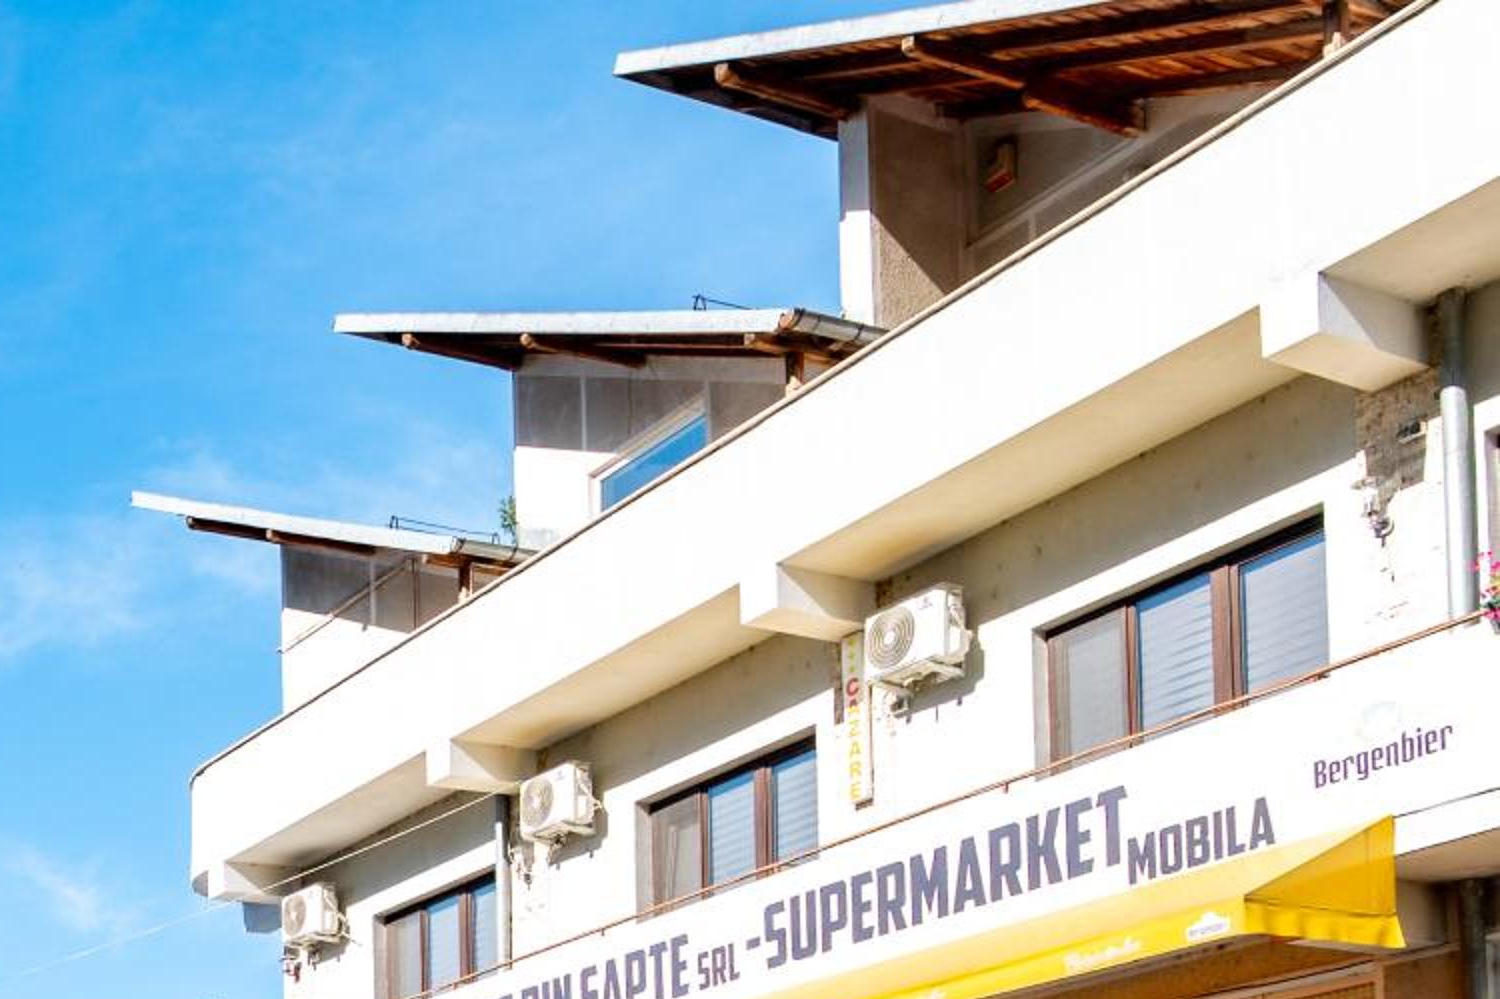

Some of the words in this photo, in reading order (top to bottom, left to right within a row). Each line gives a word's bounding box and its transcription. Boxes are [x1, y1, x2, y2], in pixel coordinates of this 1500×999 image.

[1313, 725, 1453, 789] Bergenbier
[697, 943, 740, 991] SRL
[1127, 796, 1276, 886] MOBILA
